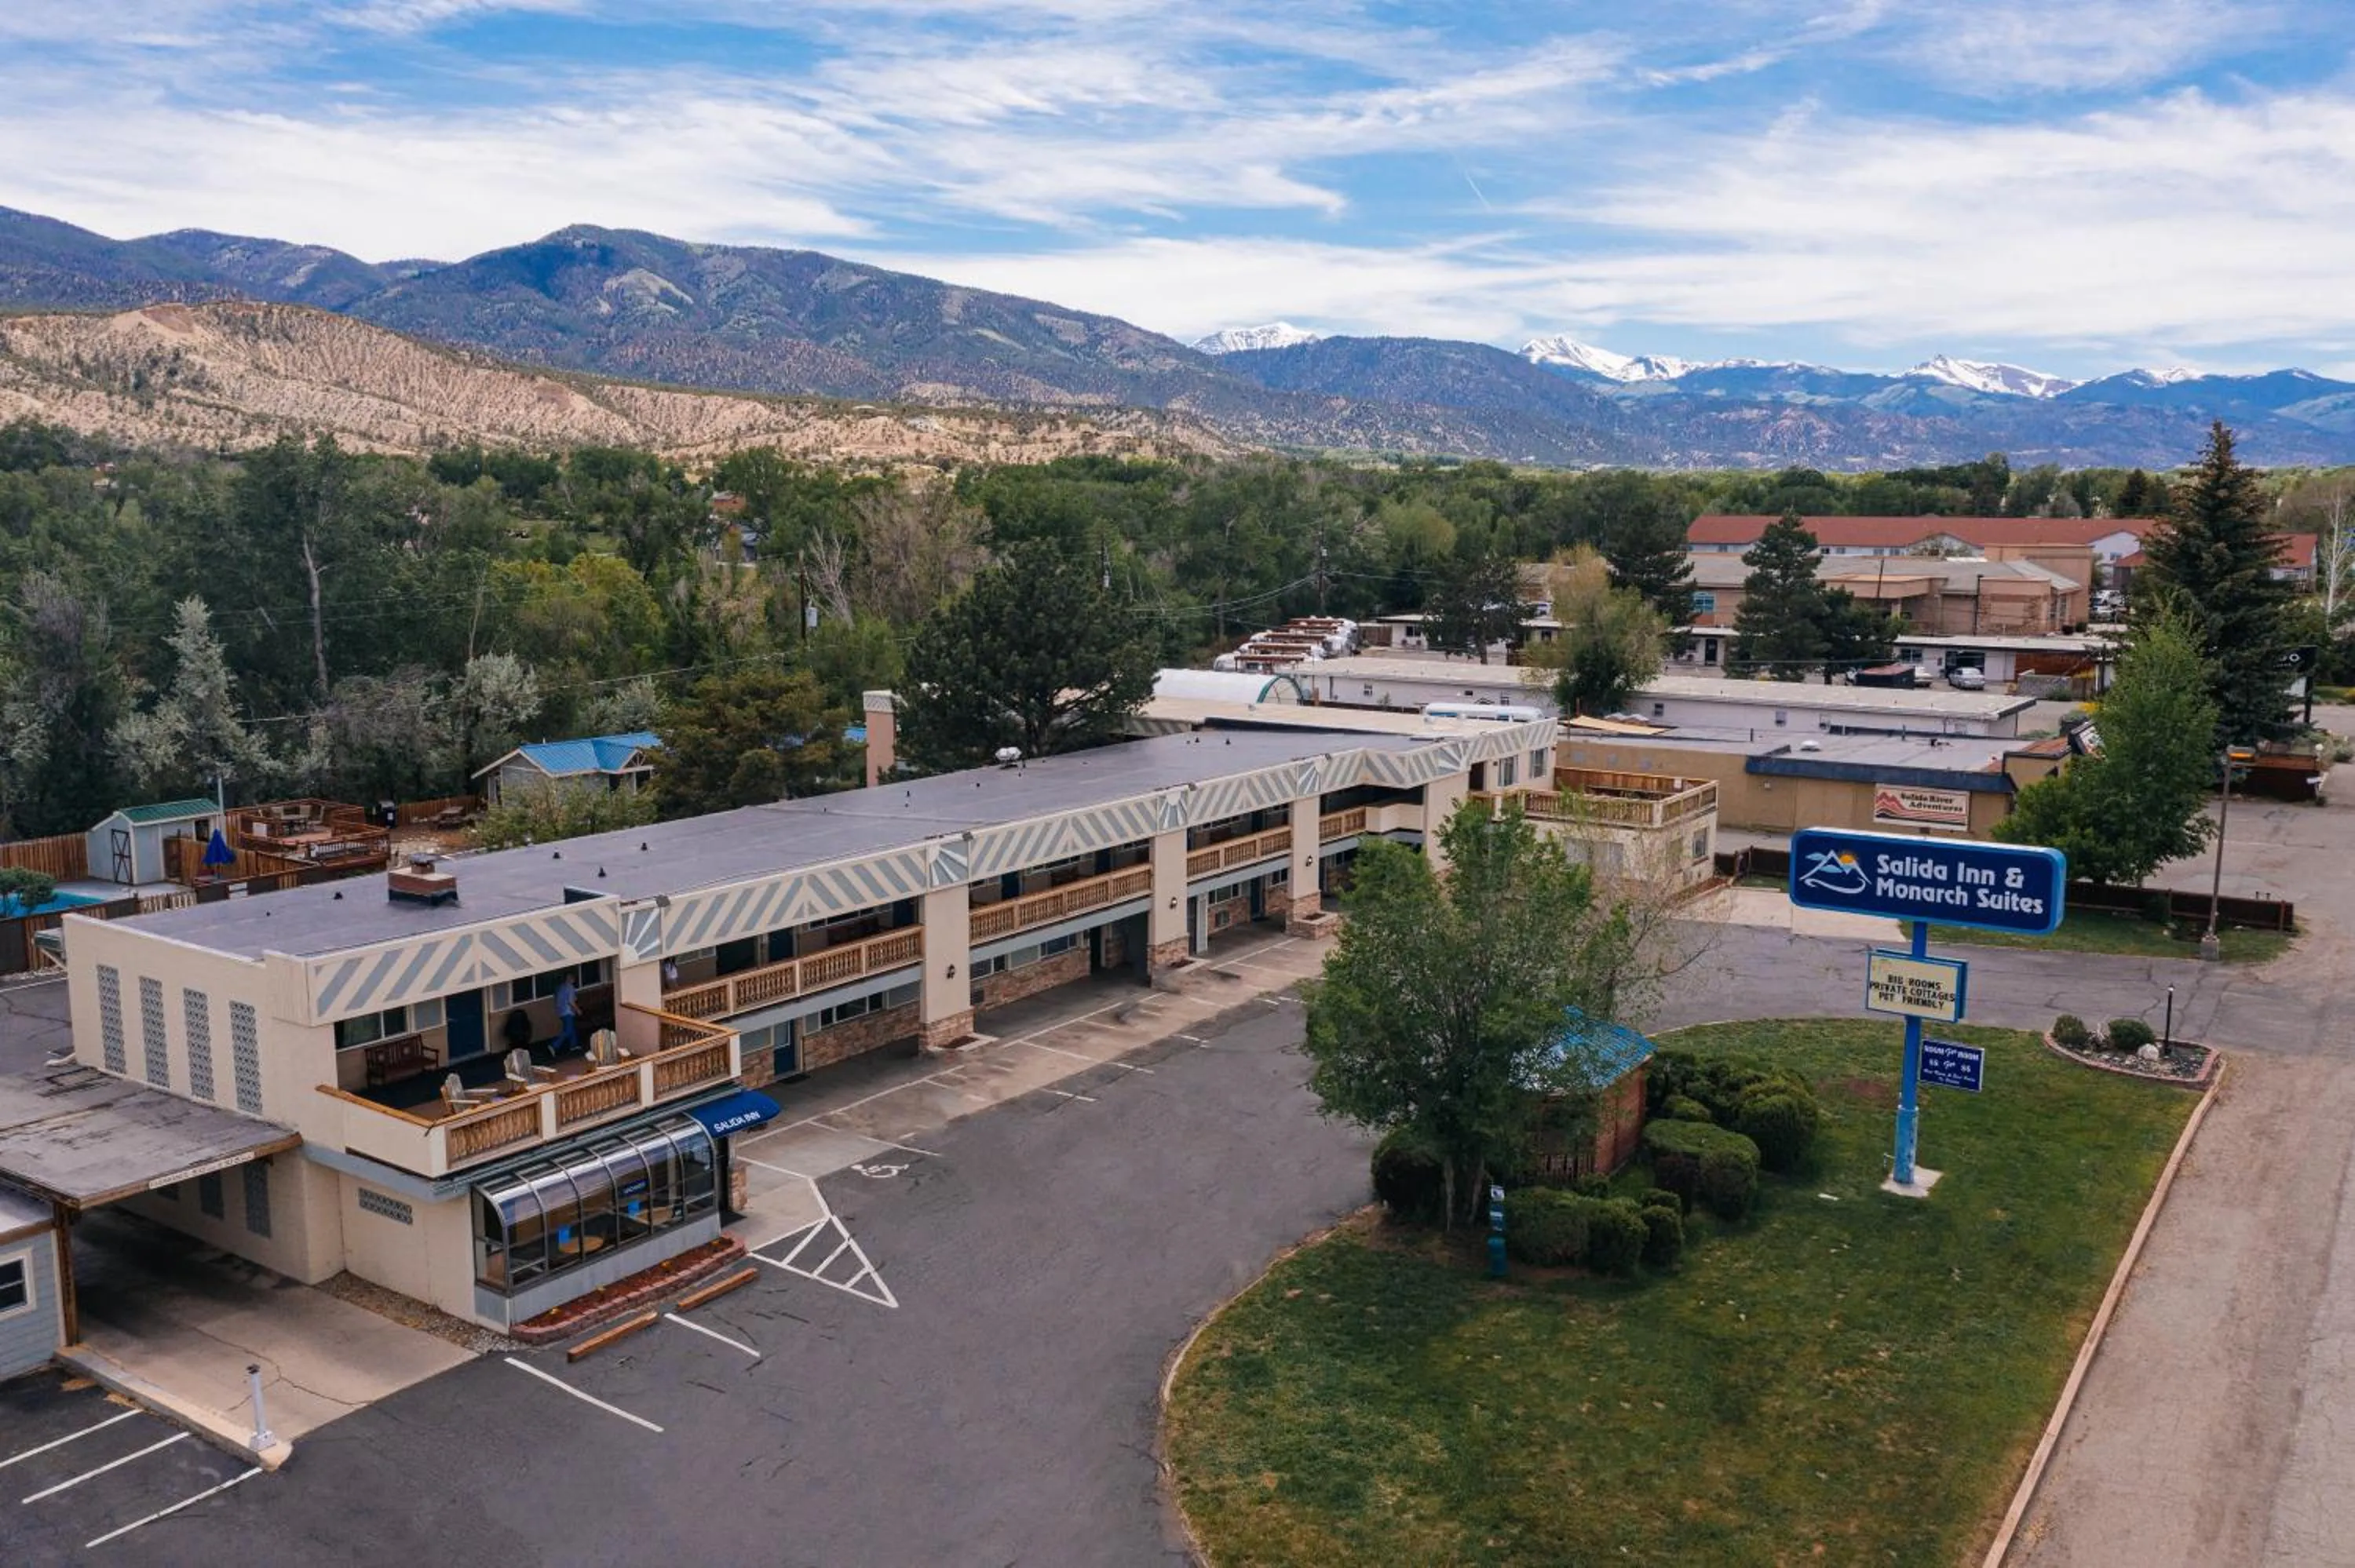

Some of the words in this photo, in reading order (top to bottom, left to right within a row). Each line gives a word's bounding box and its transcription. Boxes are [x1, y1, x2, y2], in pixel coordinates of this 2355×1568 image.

[1877, 854, 1948, 881] Salida
[1957, 862, 1995, 886] Inn
[2005, 867, 2025, 889] &
[1875, 877, 1968, 906] Monarch
[1977, 889, 2043, 915] Suites
[1869, 981, 1908, 994] PRIVATE
[1910, 988, 1955, 1002] COTTAGES
[1887, 974, 1904, 985] BIG
[1908, 978, 1941, 990] ROOMS
[1879, 991, 1893, 1002] PET
[1902, 996, 1944, 1010] FRIENDLY
[714, 1116, 747, 1132] SALIDA
[743, 1110, 761, 1122] INN
